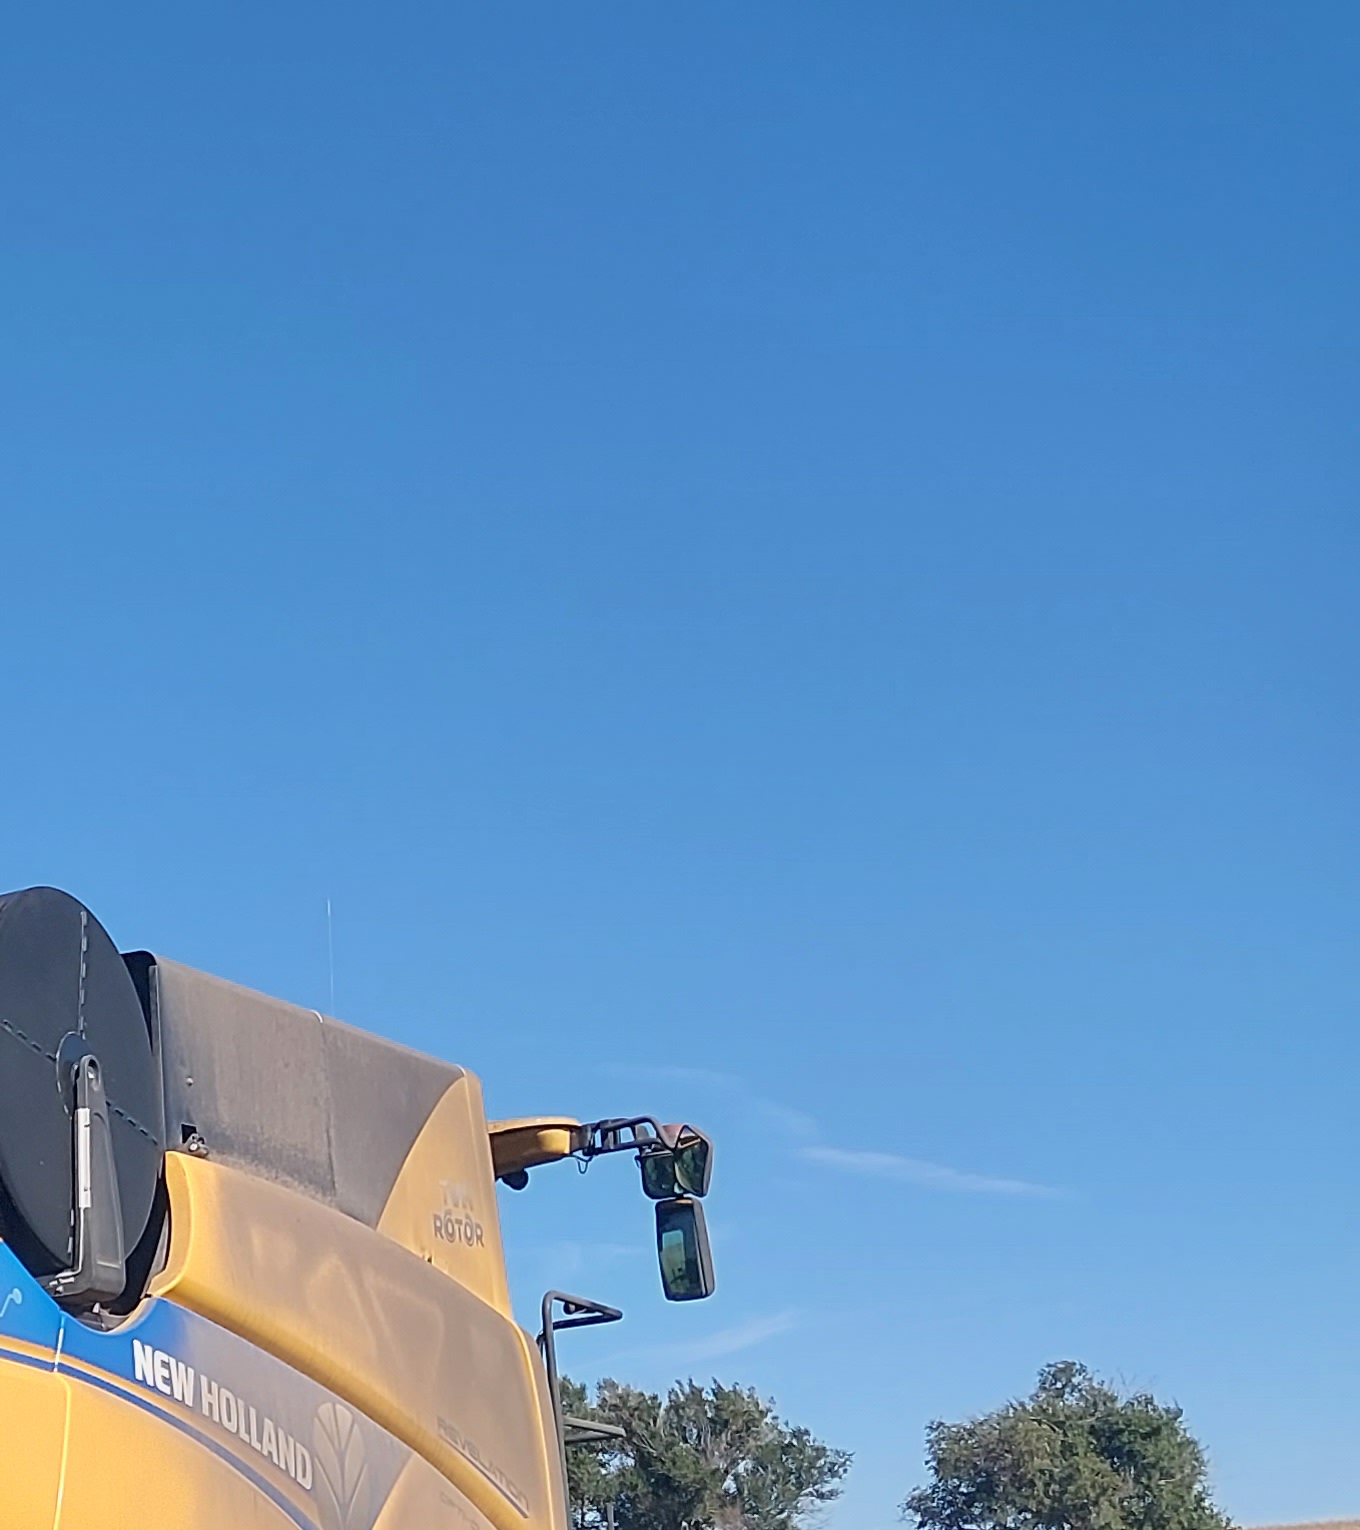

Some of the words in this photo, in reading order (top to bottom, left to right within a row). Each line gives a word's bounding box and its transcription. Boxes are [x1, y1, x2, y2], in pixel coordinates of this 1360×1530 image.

[432, 1208, 485, 1248] ROTOR
[132, 1339, 194, 1408] NEW
[199, 1373, 313, 1491] HOLLAND
